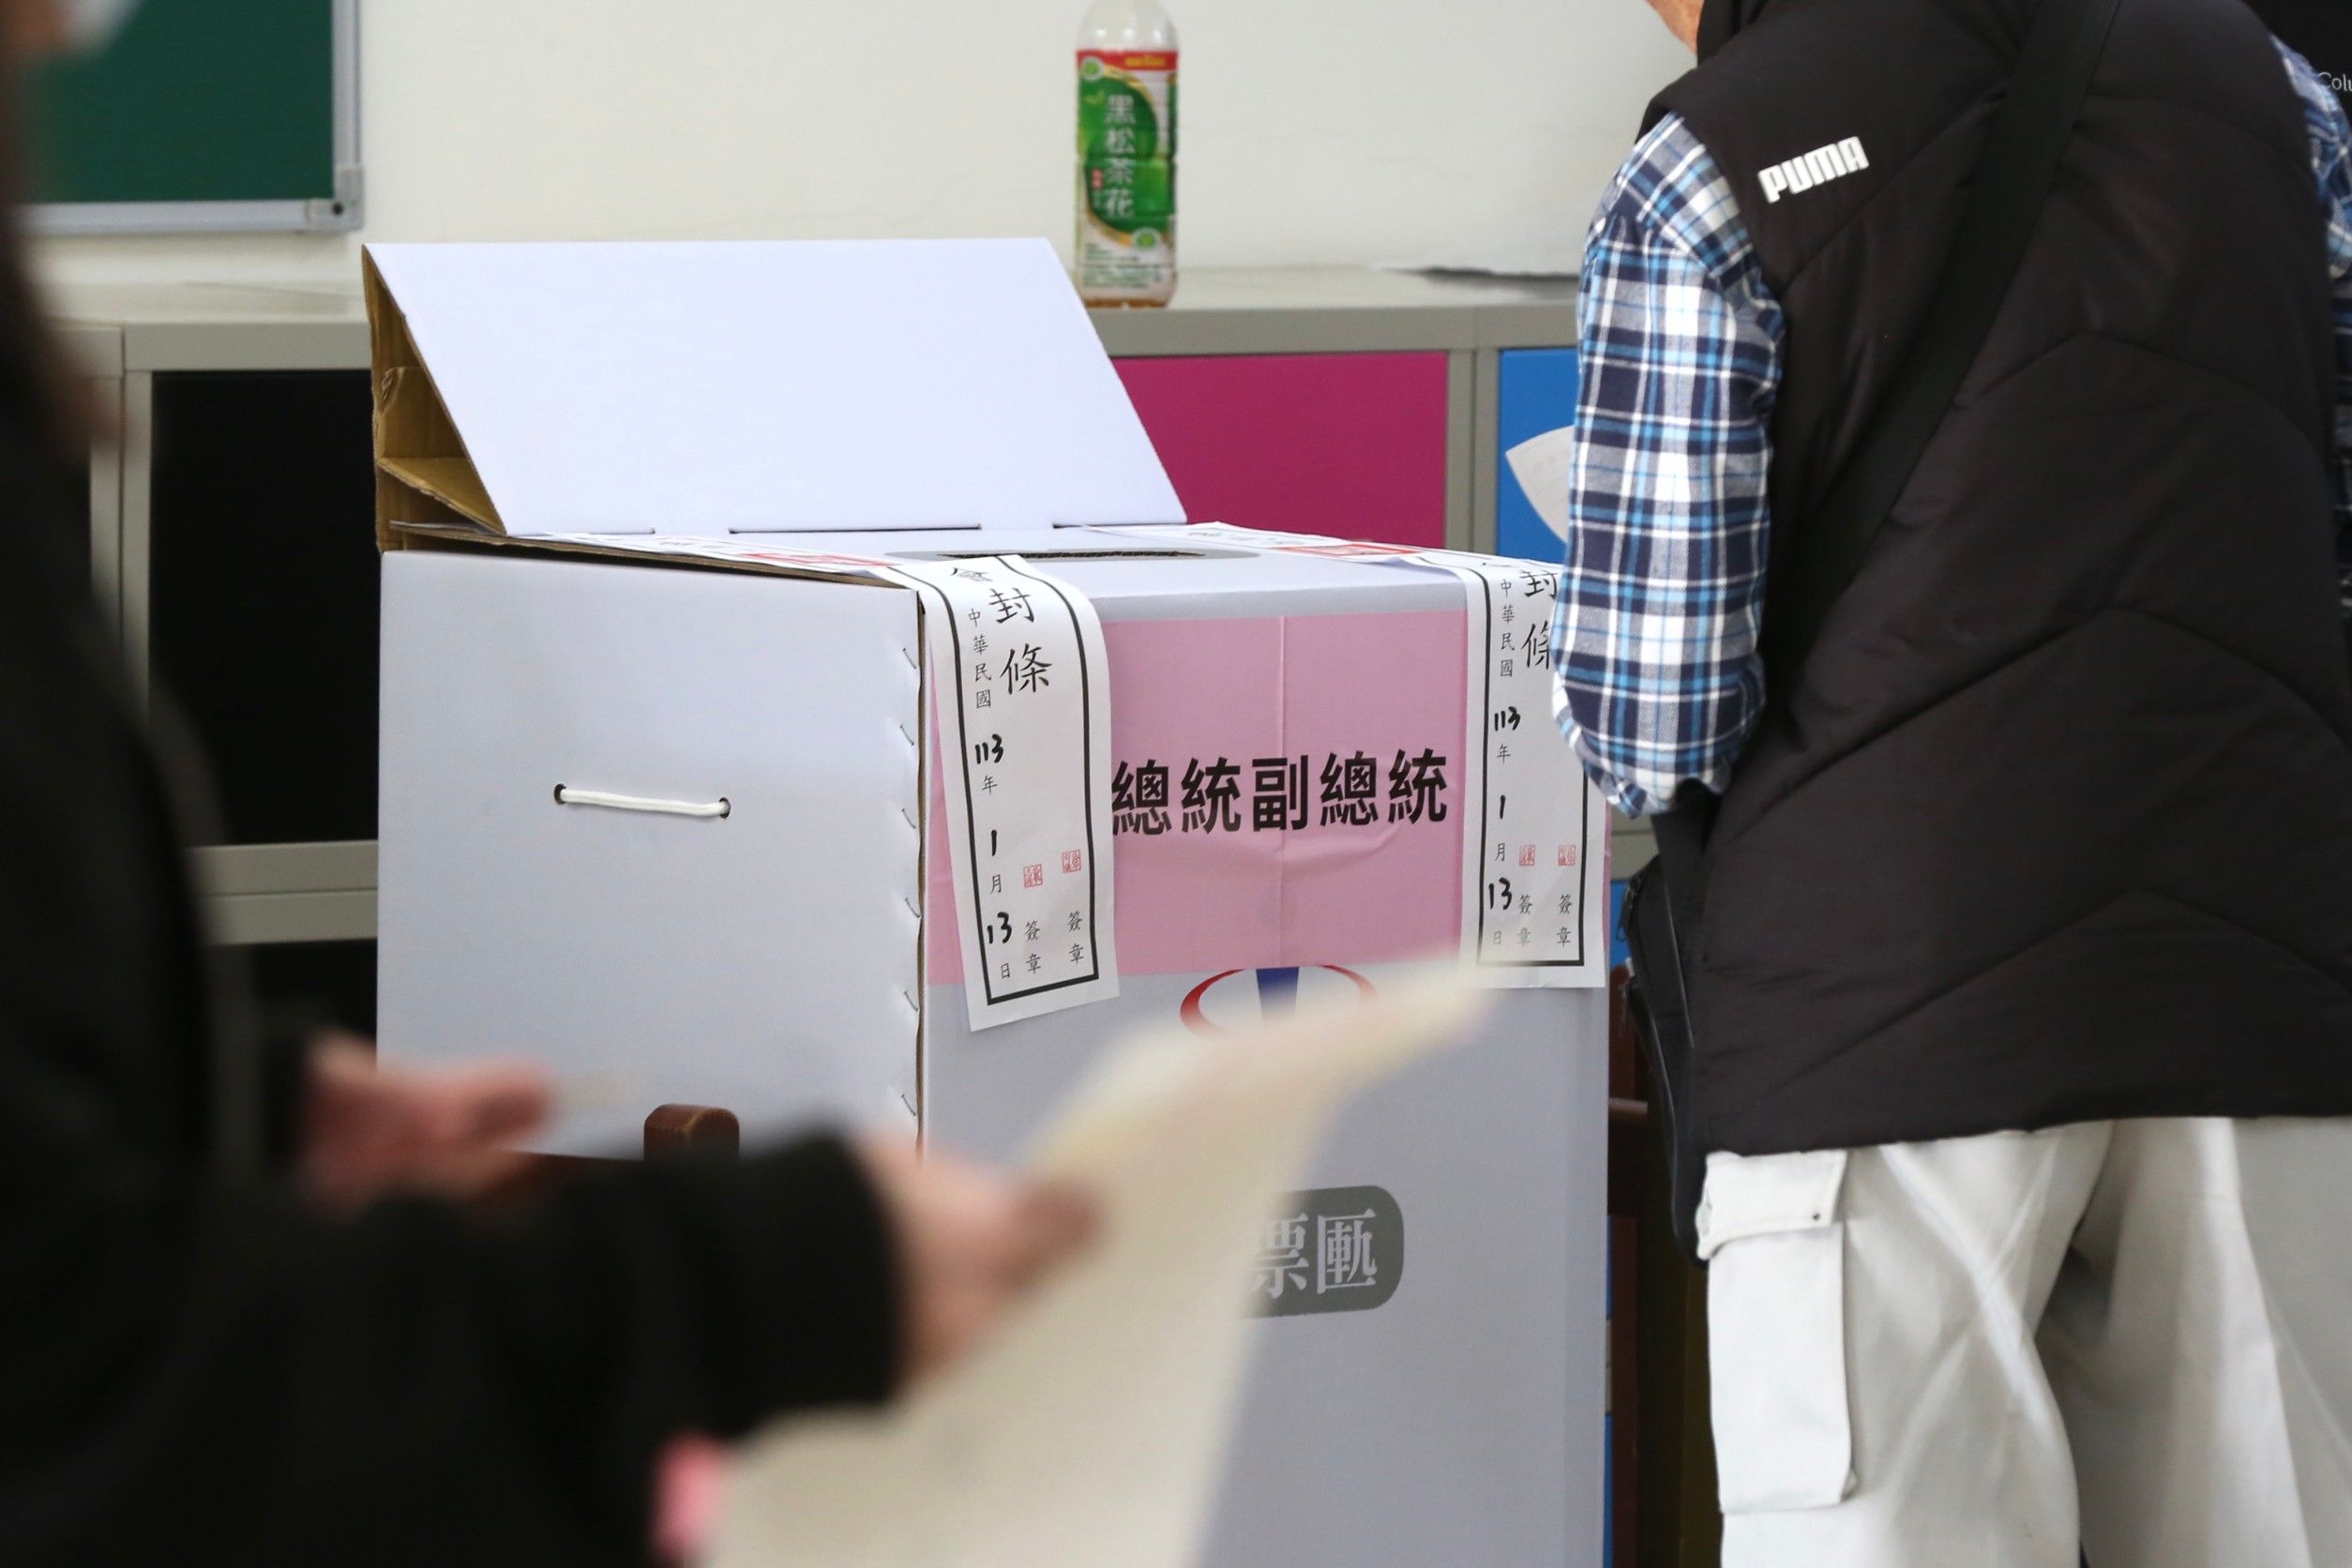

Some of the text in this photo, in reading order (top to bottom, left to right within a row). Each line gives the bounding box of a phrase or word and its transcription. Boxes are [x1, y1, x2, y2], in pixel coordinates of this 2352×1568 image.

[1106, 94, 1135, 218] 黑松茶花
[1757, 136, 1870, 204] PUMA
[988, 587, 1053, 696] 封條
[1500, 579, 1515, 678] 中華民國
[968, 608, 992, 709] 中華民國
[1493, 705, 1522, 732] 113
[974, 733, 1004, 765] 113
[1497, 743, 1512, 763] 年
[982, 775, 998, 795] 年
[1111, 747, 1448, 837] 總統副總統
[1495, 842, 1506, 862] 月
[990, 874, 1002, 894] 月
[1487, 877, 1514, 911] 13
[987, 912, 1013, 945] 13
[1066, 910, 1085, 965] 簽章
[1517, 895, 1533, 946] 簽章
[1557, 894, 1573, 947] 簽章
[1000, 962, 1011, 980] 日
[1023, 920, 1042, 974] 簽章
